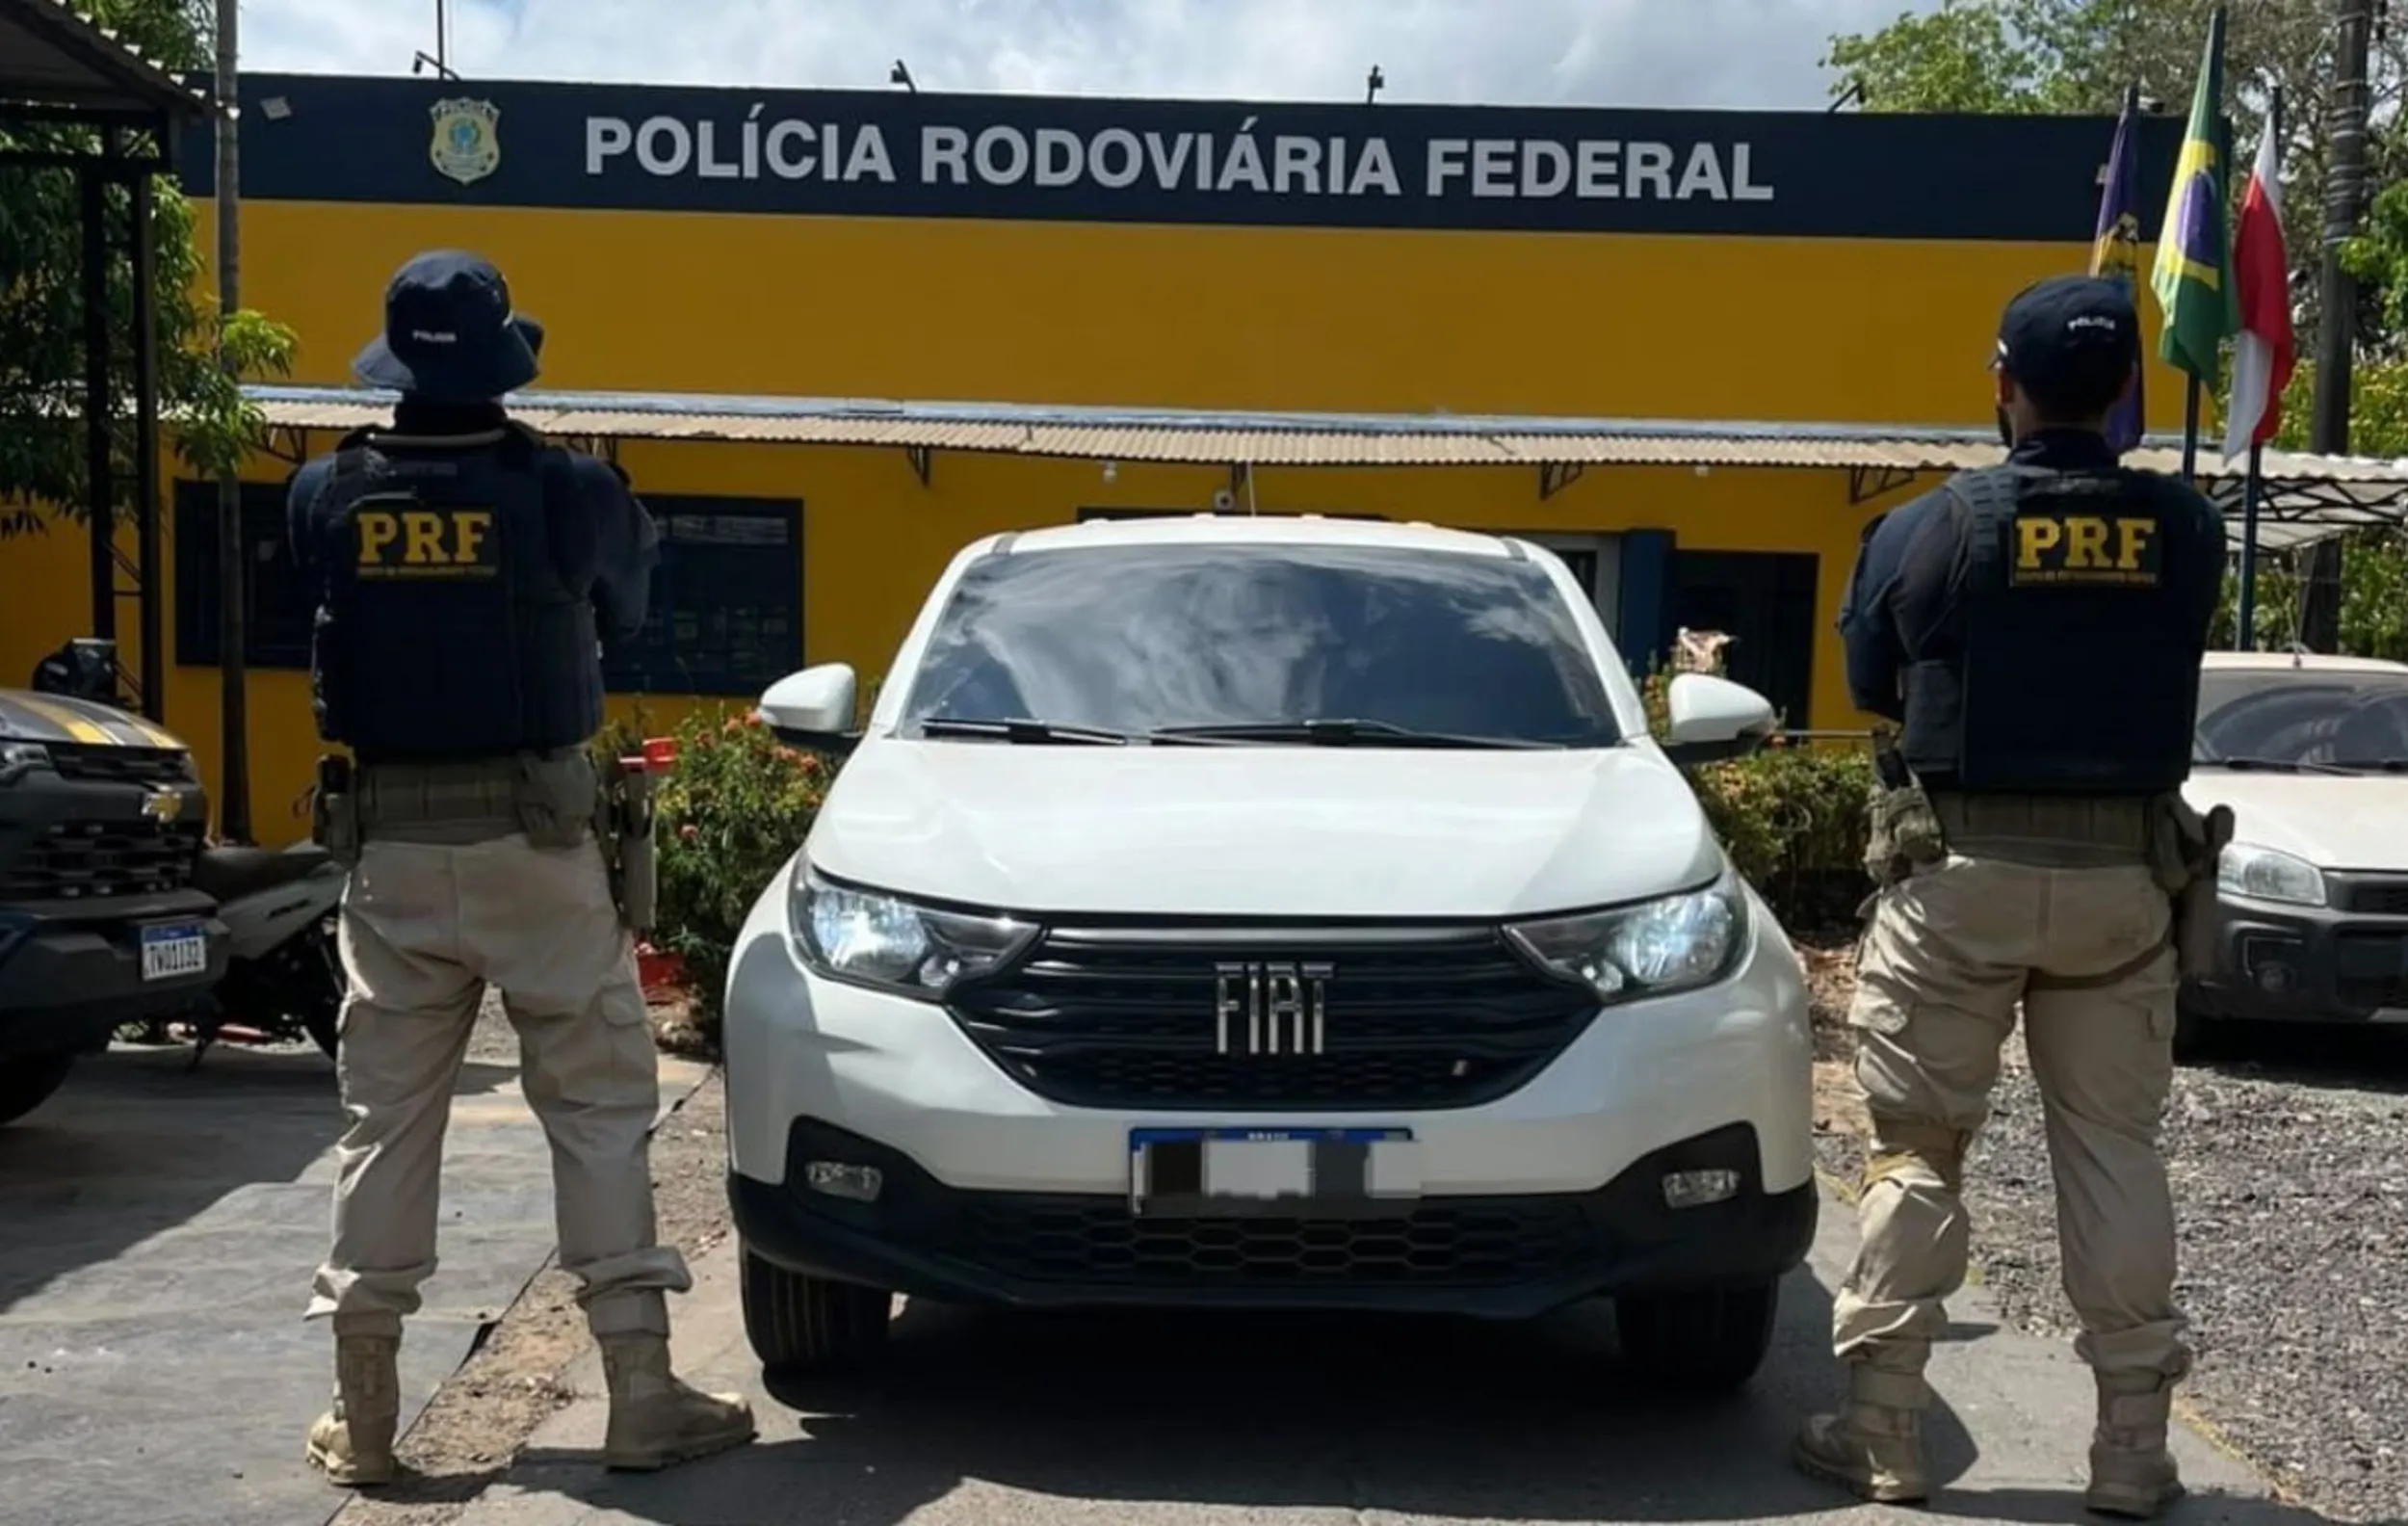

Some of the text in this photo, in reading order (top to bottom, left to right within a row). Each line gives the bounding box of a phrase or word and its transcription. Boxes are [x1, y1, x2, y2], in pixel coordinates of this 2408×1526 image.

[586, 102, 1774, 199] POLÍCIA RODOVIÁRIA FEDERAL
[357, 512, 492, 564] PRF
[2016, 517, 2156, 568] PRF
[1216, 962, 1335, 1055] FIAT
